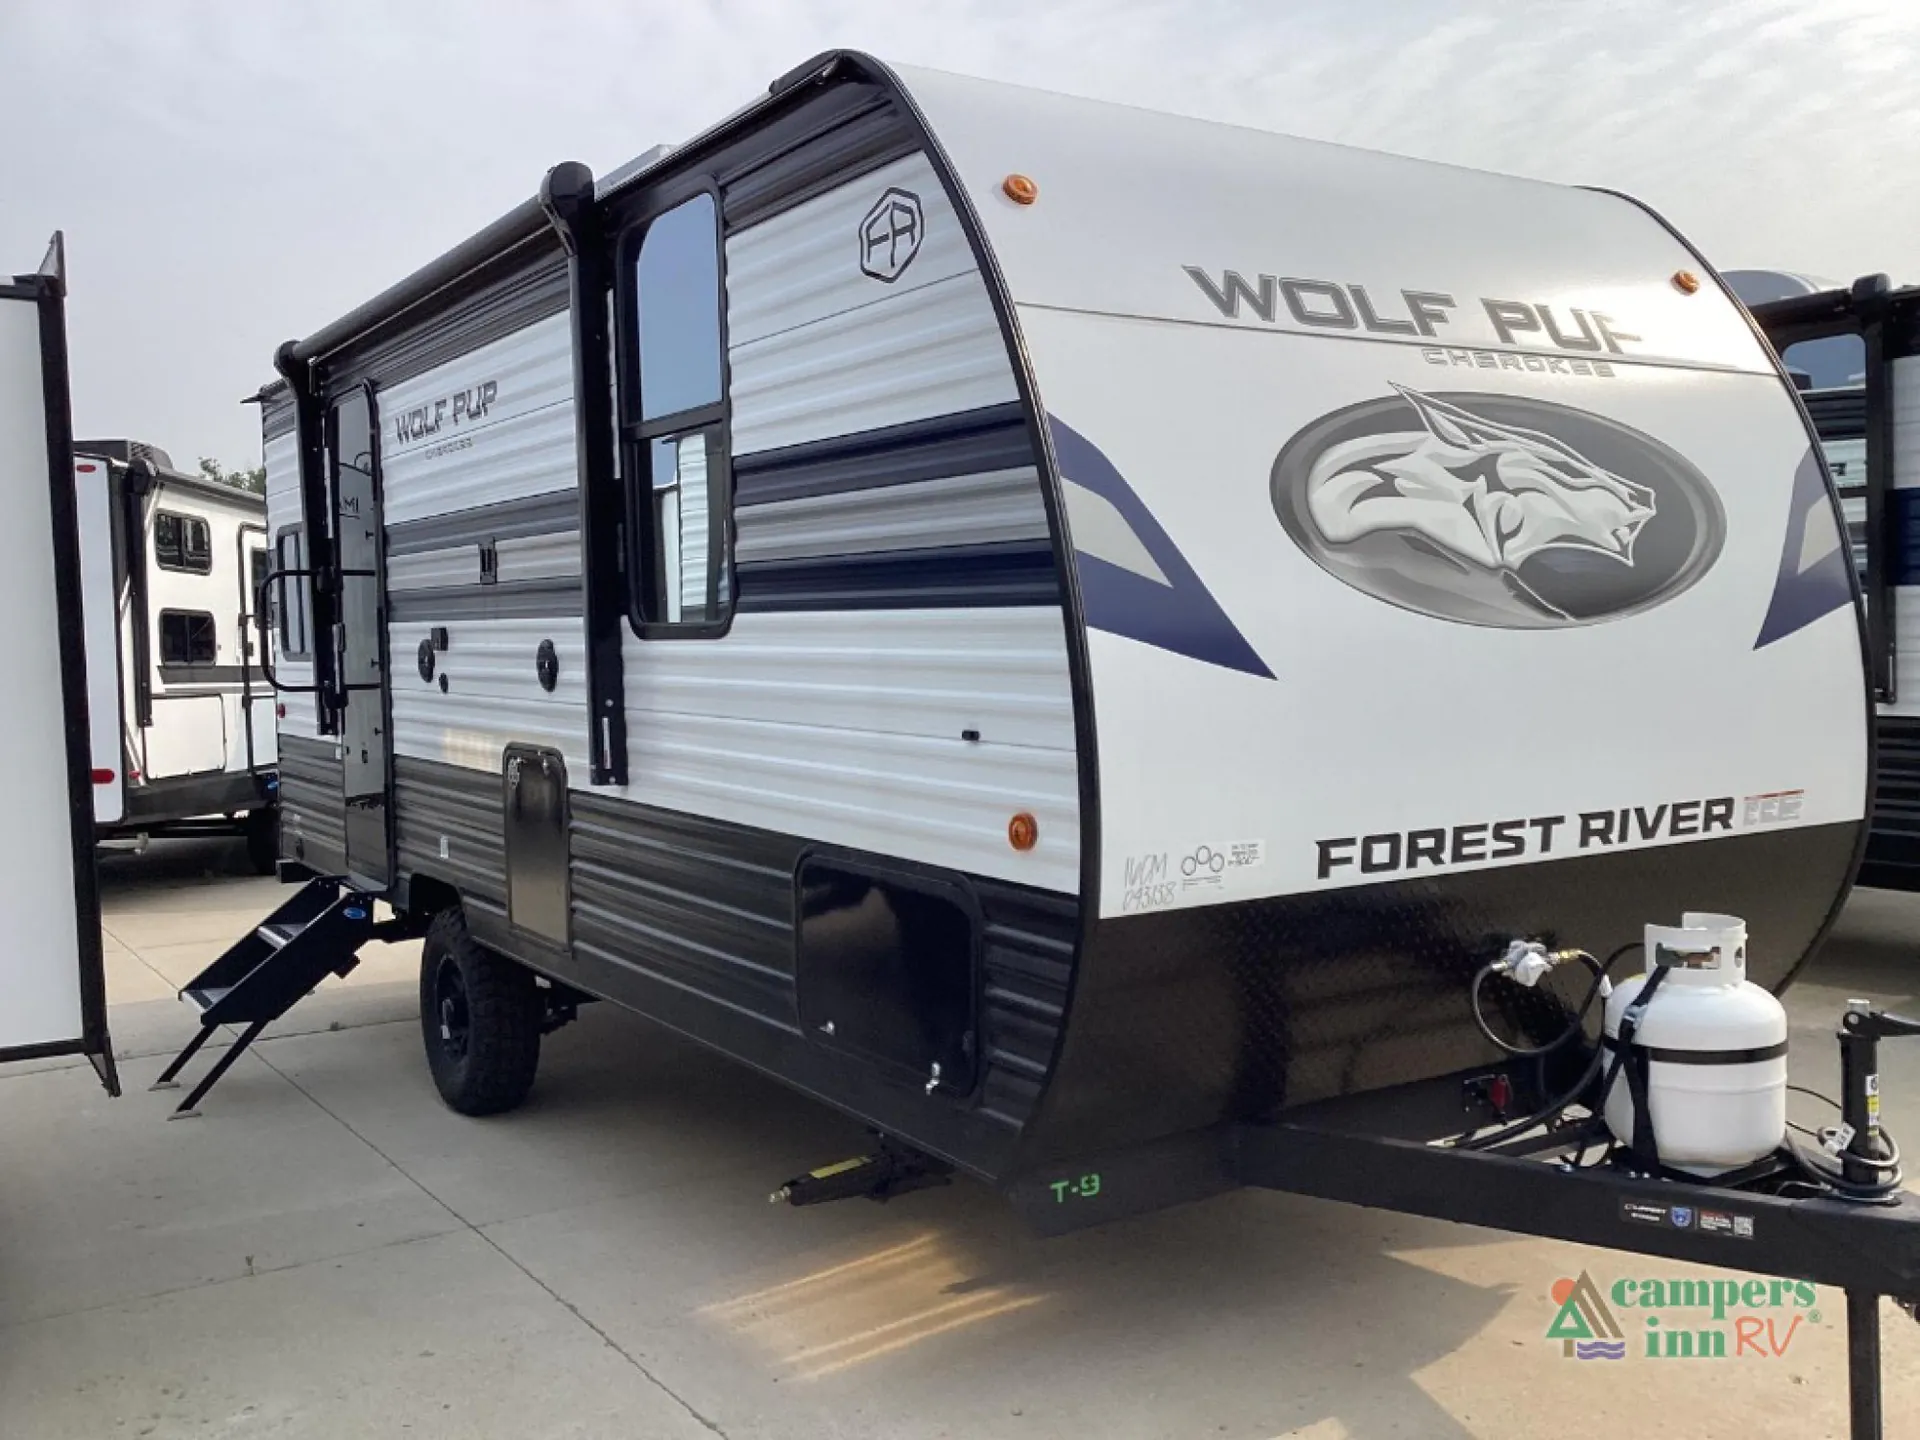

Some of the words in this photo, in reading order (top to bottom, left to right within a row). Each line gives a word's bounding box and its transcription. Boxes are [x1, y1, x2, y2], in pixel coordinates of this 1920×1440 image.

[1180, 264, 1458, 338] WOLF
[1421, 347, 1616, 378] CHEROKEE
[395, 397, 447, 446] WOLF
[452, 379, 498, 427] PUP
[1315, 815, 1567, 880] FOREST
[1578, 796, 1736, 849] RIVER
